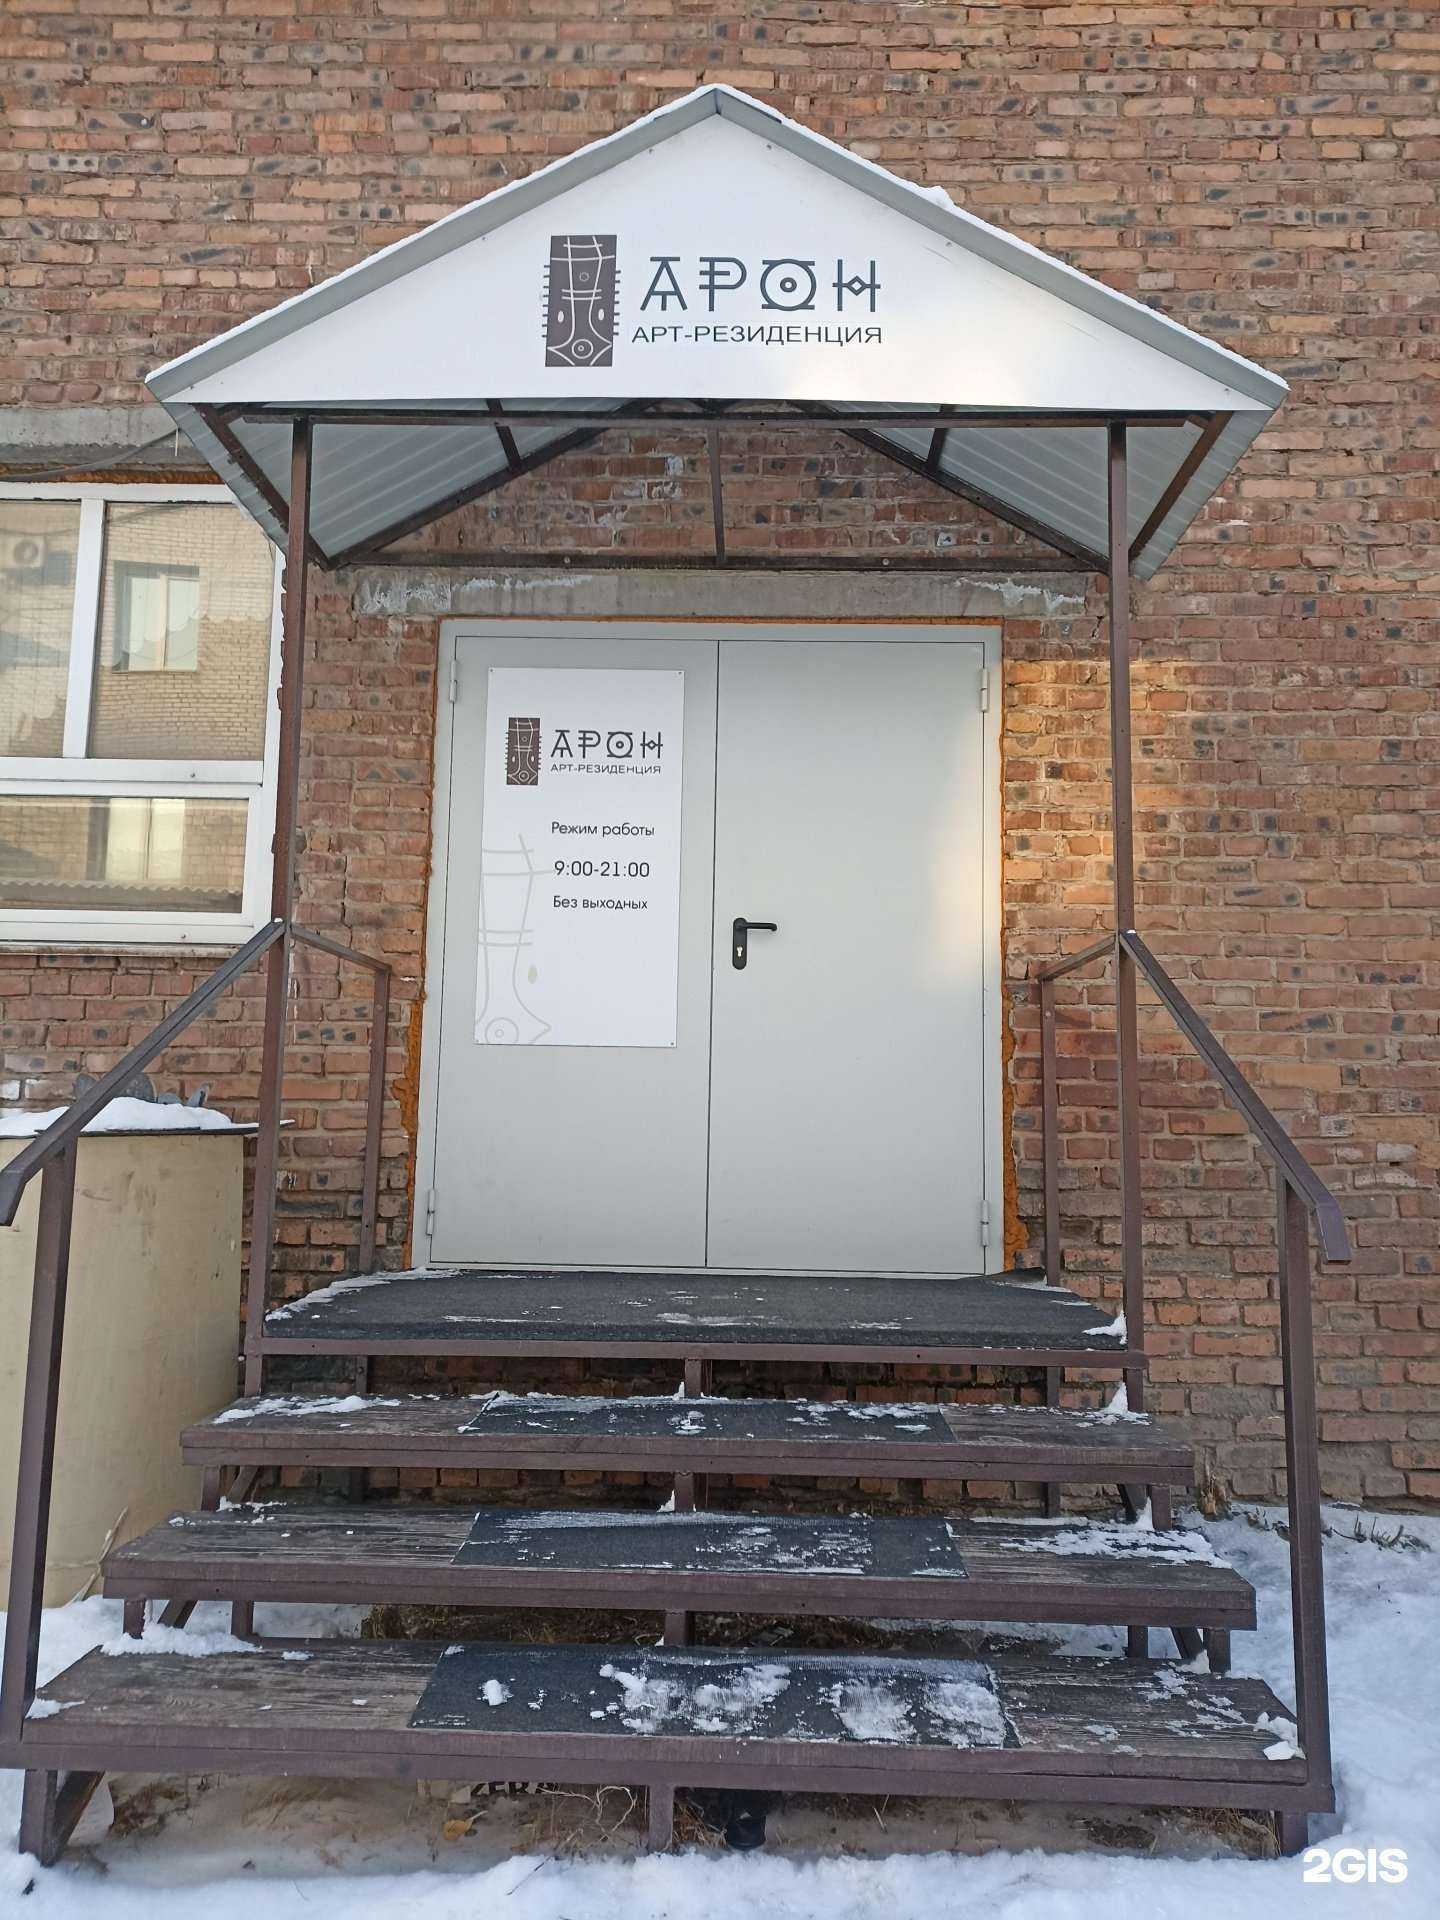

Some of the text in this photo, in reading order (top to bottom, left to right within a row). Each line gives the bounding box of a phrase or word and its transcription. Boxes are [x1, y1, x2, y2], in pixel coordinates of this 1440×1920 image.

[639, 256, 881, 312] АРОН
[631, 325, 882, 346] АРТ-РЕЗИДЕНЦИЯ
[550, 729, 663, 759] АРОН
[550, 763, 661, 774] АРТ-РЕЗИДЕНЦИЯ
[551, 821, 655, 837] Режим работы
[554, 861, 650, 877] 9:00-21:00
[553, 895, 648, 909] Без выходных
